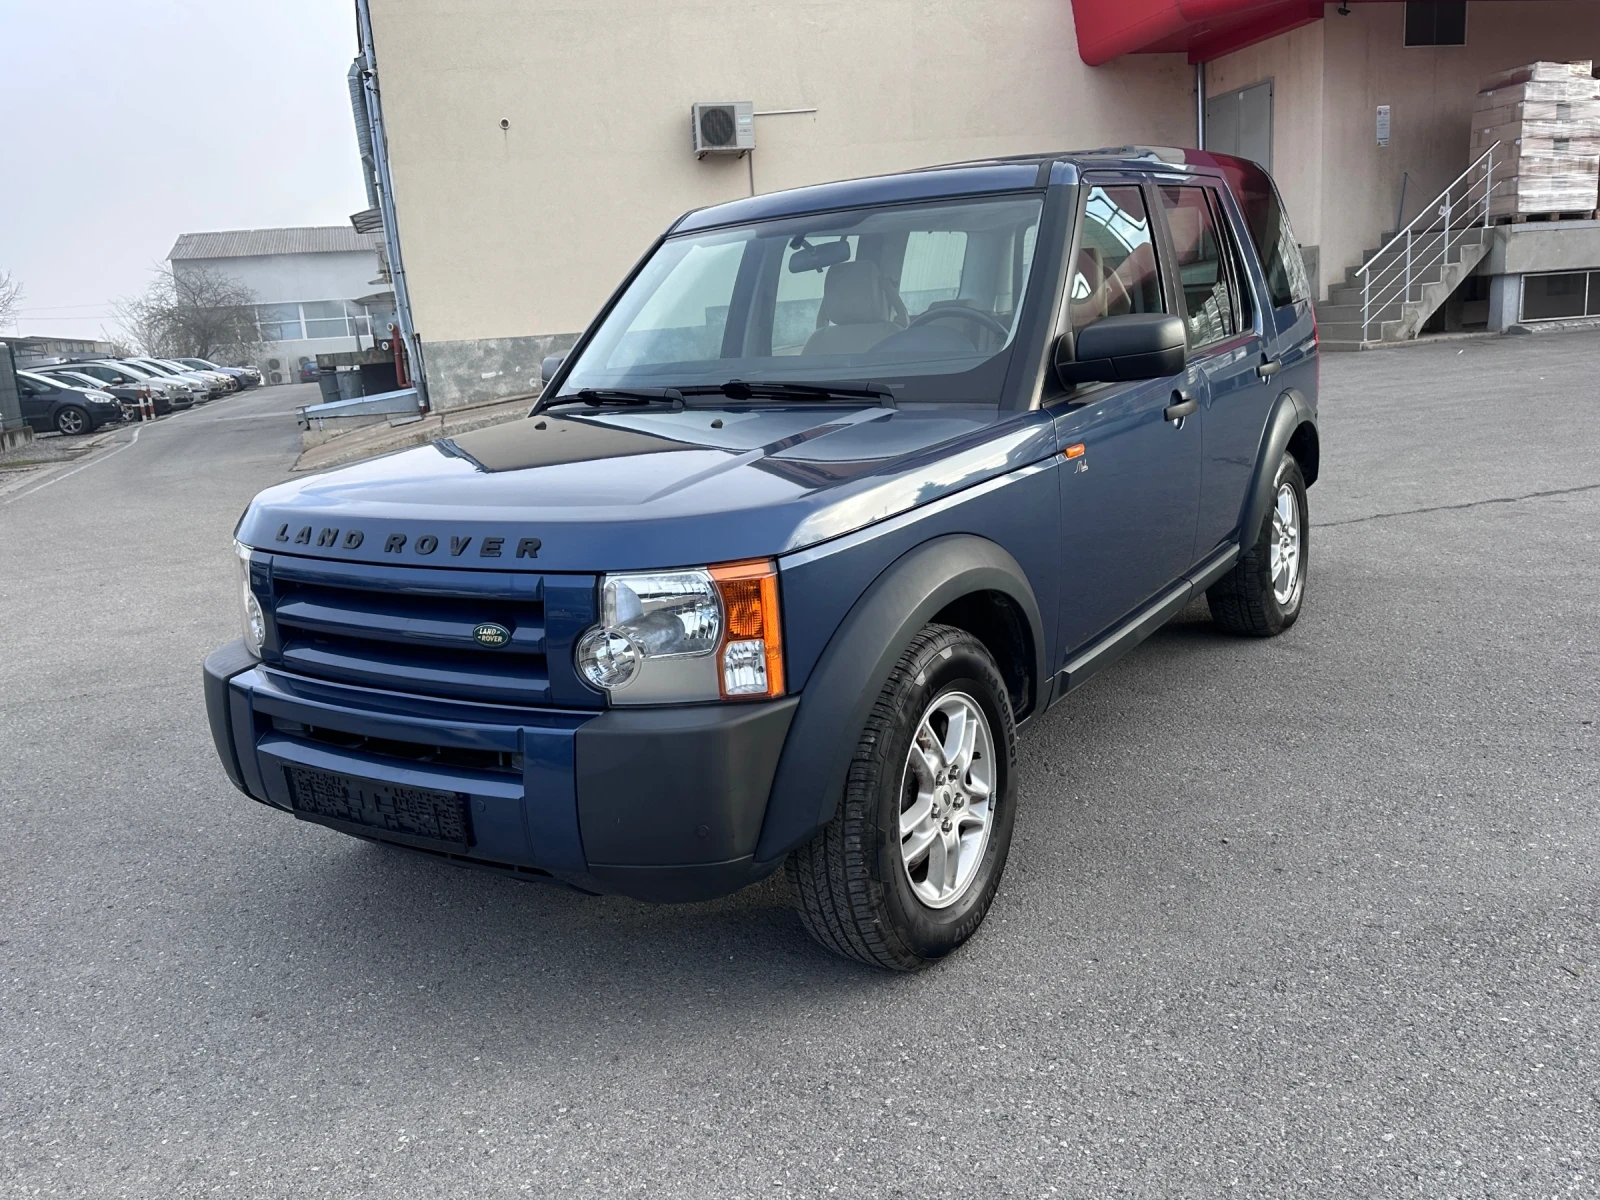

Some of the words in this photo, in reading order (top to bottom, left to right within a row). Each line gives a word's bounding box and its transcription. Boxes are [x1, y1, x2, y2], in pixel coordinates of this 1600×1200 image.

[276, 523, 364, 549] LAND
[384, 533, 542, 558] ROVER
[481, 635, 503, 643] ROVER
[998, 689, 1017, 769] Contact
